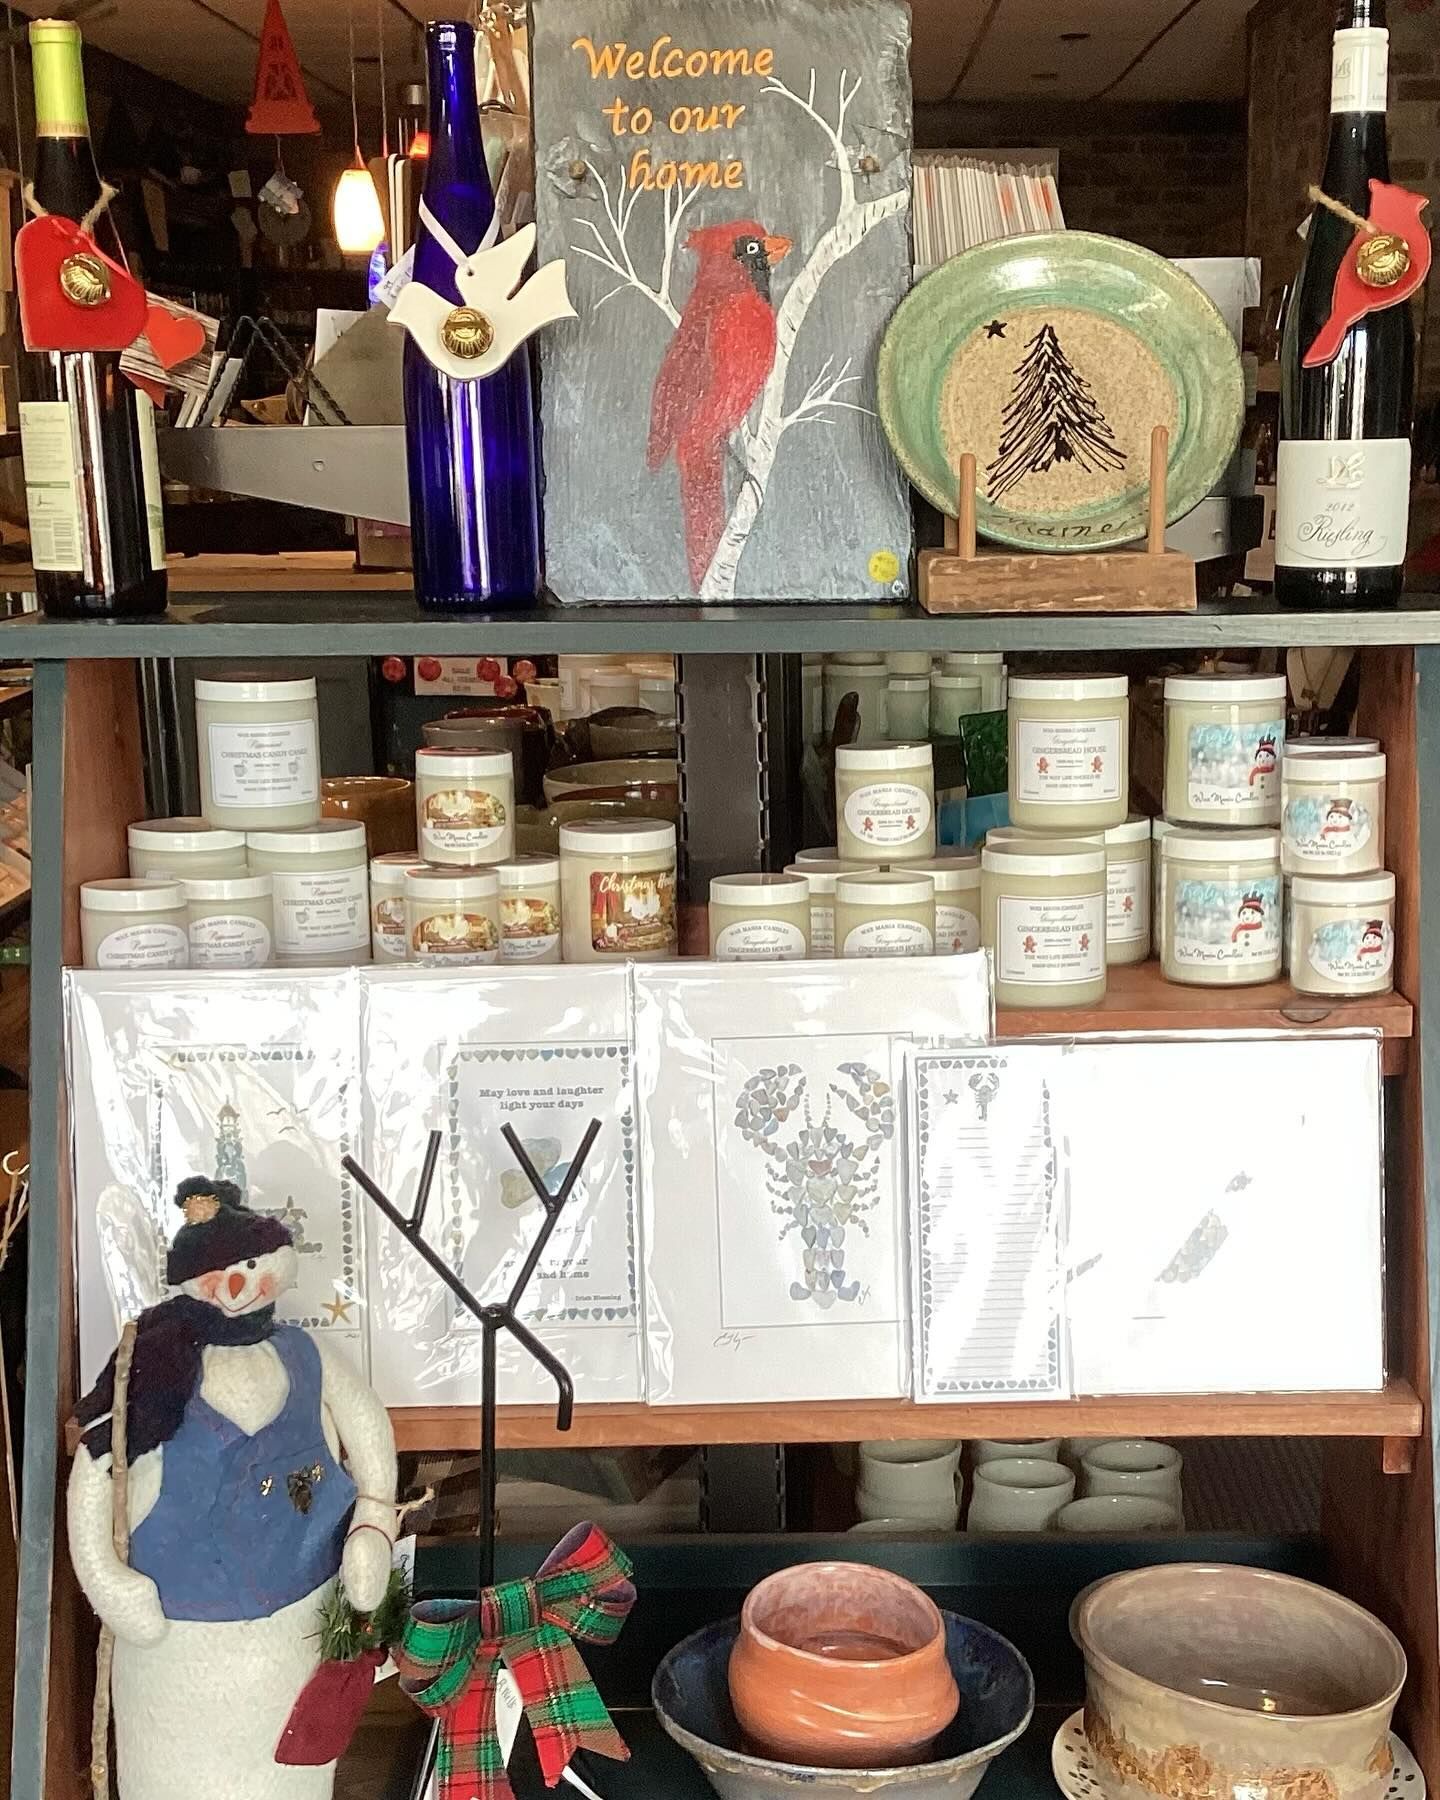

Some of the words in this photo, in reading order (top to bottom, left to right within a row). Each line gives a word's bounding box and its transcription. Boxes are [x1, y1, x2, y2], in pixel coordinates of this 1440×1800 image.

[572, 36, 775, 79] Welcome
[602, 96, 652, 136] to
[669, 103, 746, 134] our
[629, 148, 744, 191] home
[1325, 502, 1355, 512] 2012
[1297, 513, 1375, 556] Riesling
[220, 751, 262, 759] CHRISTMAS
[262, 750, 288, 758] CANDY
[1083, 745, 1107, 753] HOUSE
[600, 872, 656, 894] Christmas
[325, 897, 347, 905] CANDY
[479, 1089, 504, 1099] May
[506, 1088, 530, 1097] love
[533, 1087, 554, 1096] and
[556, 1086, 604, 1097] laughter
[500, 1100, 527, 1111] light
[528, 1101, 555, 1111] your
[557, 1100, 584, 1110] days
